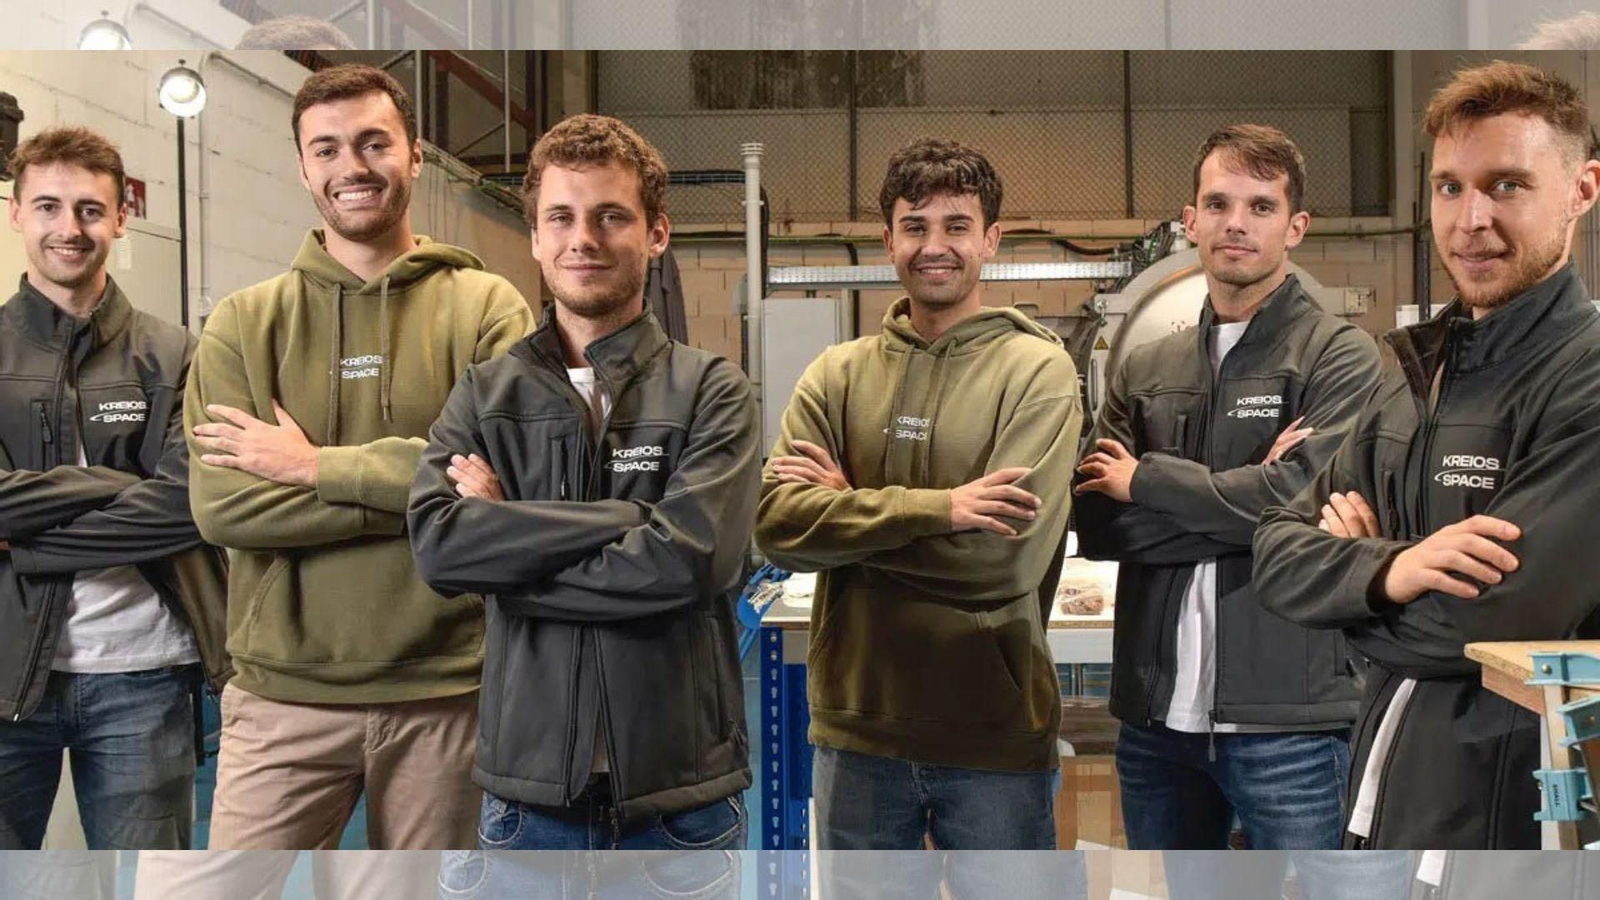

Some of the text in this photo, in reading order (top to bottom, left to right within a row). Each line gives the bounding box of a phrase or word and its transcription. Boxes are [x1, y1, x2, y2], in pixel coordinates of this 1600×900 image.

[341, 367, 380, 379] SPACE
[98, 400, 147, 411] KREIOS
[1236, 394, 1282, 406] KREIOS
[102, 412, 146, 423] SPACE
[1236, 407, 1280, 419] SPACE
[895, 429, 929, 440] SPAC
[612, 445, 664, 459] KREIOS
[613, 460, 660, 472] SPACE
[1442, 454, 1500, 470] KREIOS
[1442, 473, 1496, 490] SPACE
